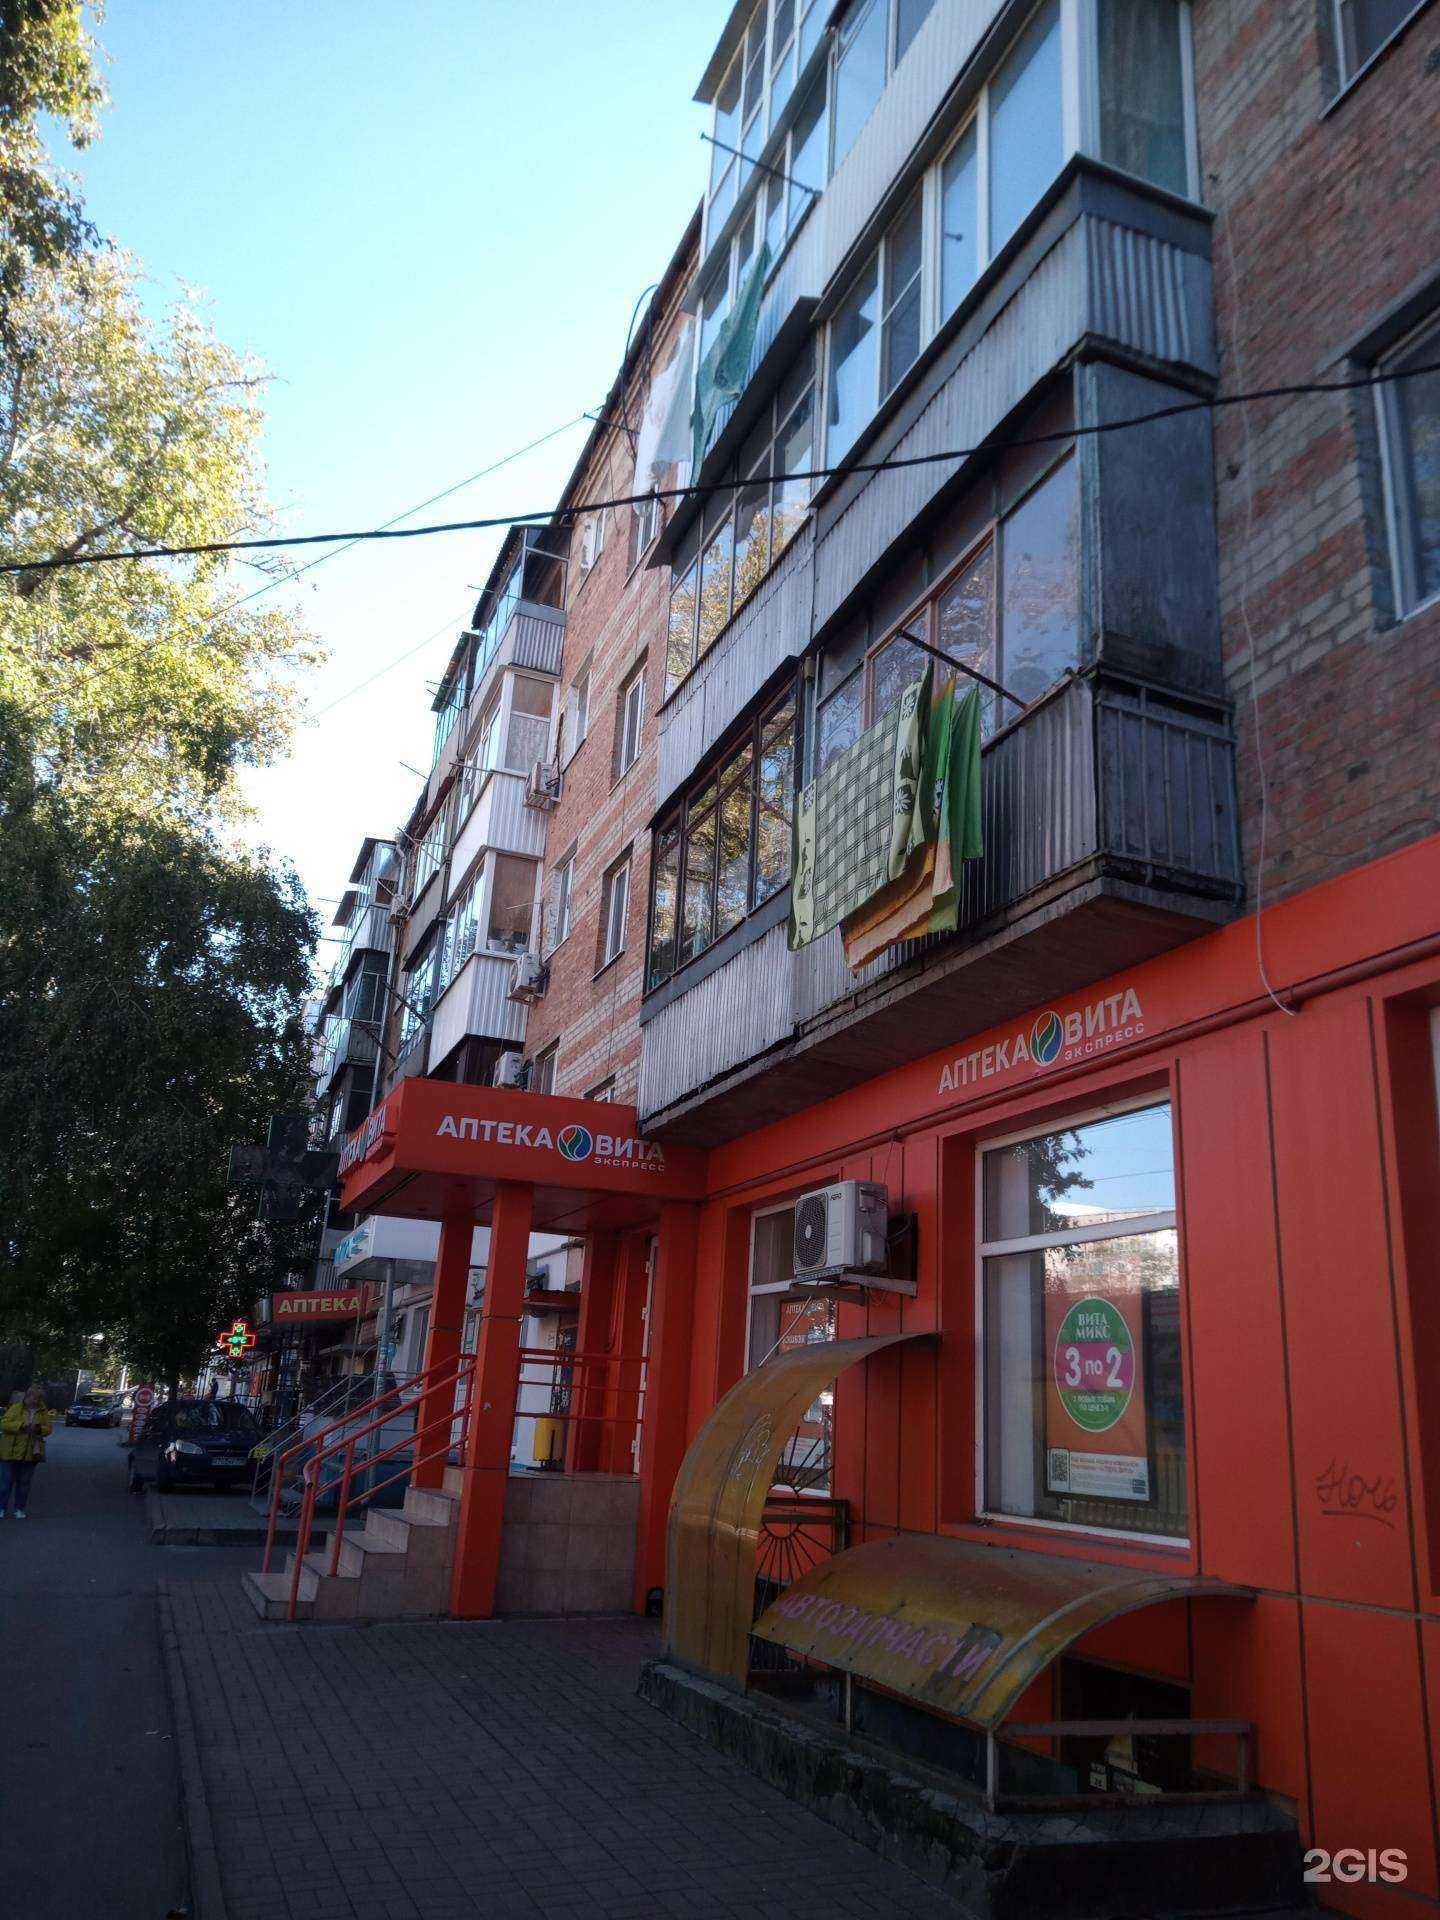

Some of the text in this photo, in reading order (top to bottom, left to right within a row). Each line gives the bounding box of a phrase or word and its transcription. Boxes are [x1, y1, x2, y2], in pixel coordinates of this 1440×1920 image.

[937, 987, 1144, 1095] АПТЕКА ВИТА
[1064, 1021, 1146, 1062] ЭКСПРЕСС
[436, 1115, 665, 1162] АПТЕКА ВИТА
[593, 1157, 666, 1173] ЭКСПРЕСС
[278, 1296, 361, 1314] АПТЕКА
[1065, 1346, 1082, 1387] 3
[1106, 1346, 1124, 1388] 2
